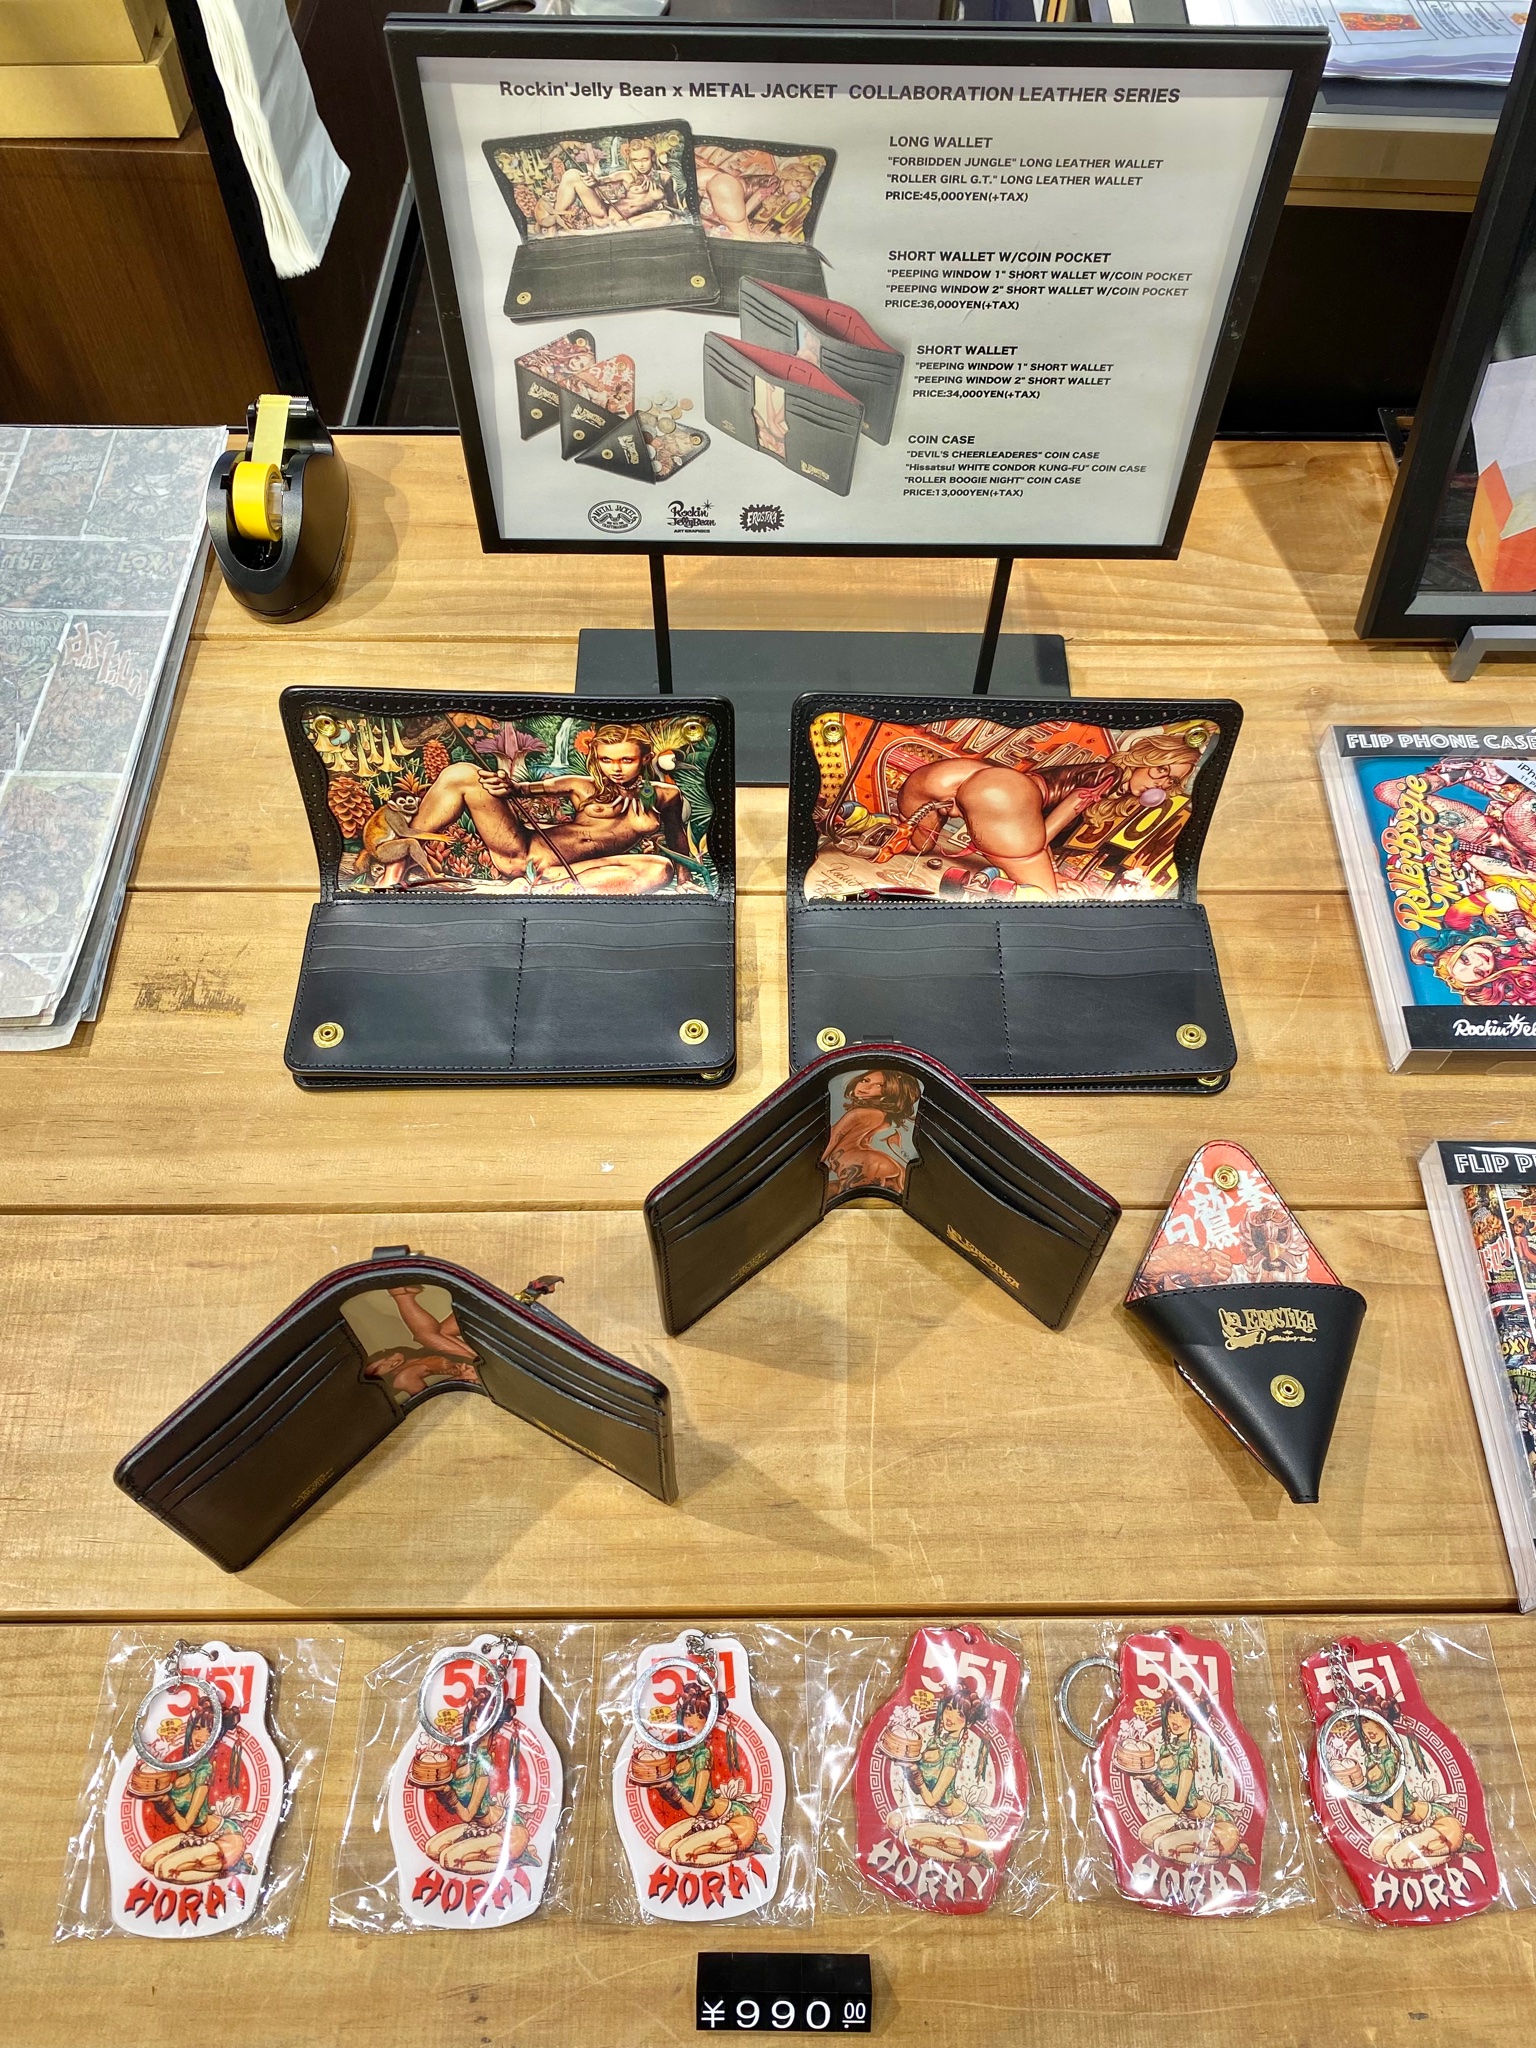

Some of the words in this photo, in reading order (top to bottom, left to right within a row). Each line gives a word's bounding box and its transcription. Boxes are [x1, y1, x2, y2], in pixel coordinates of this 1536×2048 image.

[620, 82, 667, 97] Bean
[672, 86, 683, 97] x
[689, 82, 755, 98] METAL
[760, 84, 837, 99] JACKET
[849, 85, 1014, 102] COLLABORATION
[1020, 87, 1107, 103] LEATHER
[1113, 88, 1181, 103] SERIES
[890, 136, 930, 148] LONG
[934, 137, 993, 149] WALLET
[888, 156, 961, 167] "FORBIDDEN
[965, 157, 1017, 167] JUNGLE"
[1020, 158, 1053, 168] LONG
[1056, 159, 1111, 168] LEATHER
[1114, 159, 1163, 169] WALLET
[887, 174, 937, 184] "ROLLER
[940, 174, 967, 184] GIRL
[970, 175, 997, 185] G.T."
[1000, 175, 1033, 185] LONG
[1036, 176, 1090, 185] LEATHER
[1094, 176, 1143, 186] WALLET
[885, 191, 1028, 203] PRICE:45,000YEN(+TAX)
[889, 250, 936, 261] SHORT
[940, 251, 995, 262] WALLET
[999, 252, 1050, 263] W/COIN
[1055, 252, 1111, 264] POCKET
[888, 269, 939, 278] "PEEPING
[942, 270, 990, 279] WINDOW
[1009, 271, 1048, 279] SHORT
[1051, 271, 1097, 280] WALLET
[1099, 271, 1143, 281] W/COIN
[1146, 272, 1192, 282] POCKET
[886, 284, 938, 293] "PEEPING
[940, 285, 989, 294] WINDOW
[992, 285, 1004, 294] 2"
[1006, 286, 1046, 295] SHORT
[1048, 286, 1094, 295] WALLET
[1096, 287, 1139, 296] W/COIN
[1142, 287, 1188, 297] POCKET
[885, 299, 1020, 310] PRICE:36,000YEN(+TAX)
[917, 345, 962, 355] SHORT
[965, 346, 1018, 355] WALLET
[916, 362, 964, 371] "PEEPING
[968, 363, 1014, 371] WINDOW
[1030, 363, 1068, 371] SHORT
[1070, 364, 1114, 372] WALLET
[914, 376, 962, 384] "PEEPING
[966, 376, 1012, 384] WINDOW
[1014, 377, 1026, 385] 2"
[1028, 377, 1066, 385] SHORT
[1068, 377, 1111, 385] WALLET
[913, 390, 1041, 399] PRICE:34,000YEN(+TAX)
[908, 435, 938, 444] COIN
[942, 436, 976, 445] CASE
[952, 451, 1042, 459] CHEERLEADERES"
[906, 463, 955, 471] "Hissatsu!
[993, 464, 1036, 472] CONDOR
[1038, 464, 1090, 472] KUNG-FU"
[1119, 465, 1147, 473] CASE
[905, 476, 947, 484] "ROLLER
[1027, 477, 1052, 485] COIN
[1054, 477, 1081, 485] CASE
[903, 489, 1024, 497] PRICE:13,000YEN(+TAX)
[594, 505, 613, 518] METAL
[615, 505, 636, 518] JACKET
[1346, 734, 1394, 749] FLIP
[1398, 734, 1479, 749] PHONE
[1454, 1154, 1509, 1174] FLIP
[1514, 1154, 1536, 1174] P
[1136, 1651, 1219, 1701] 551
[443, 1659, 527, 1708] 551
